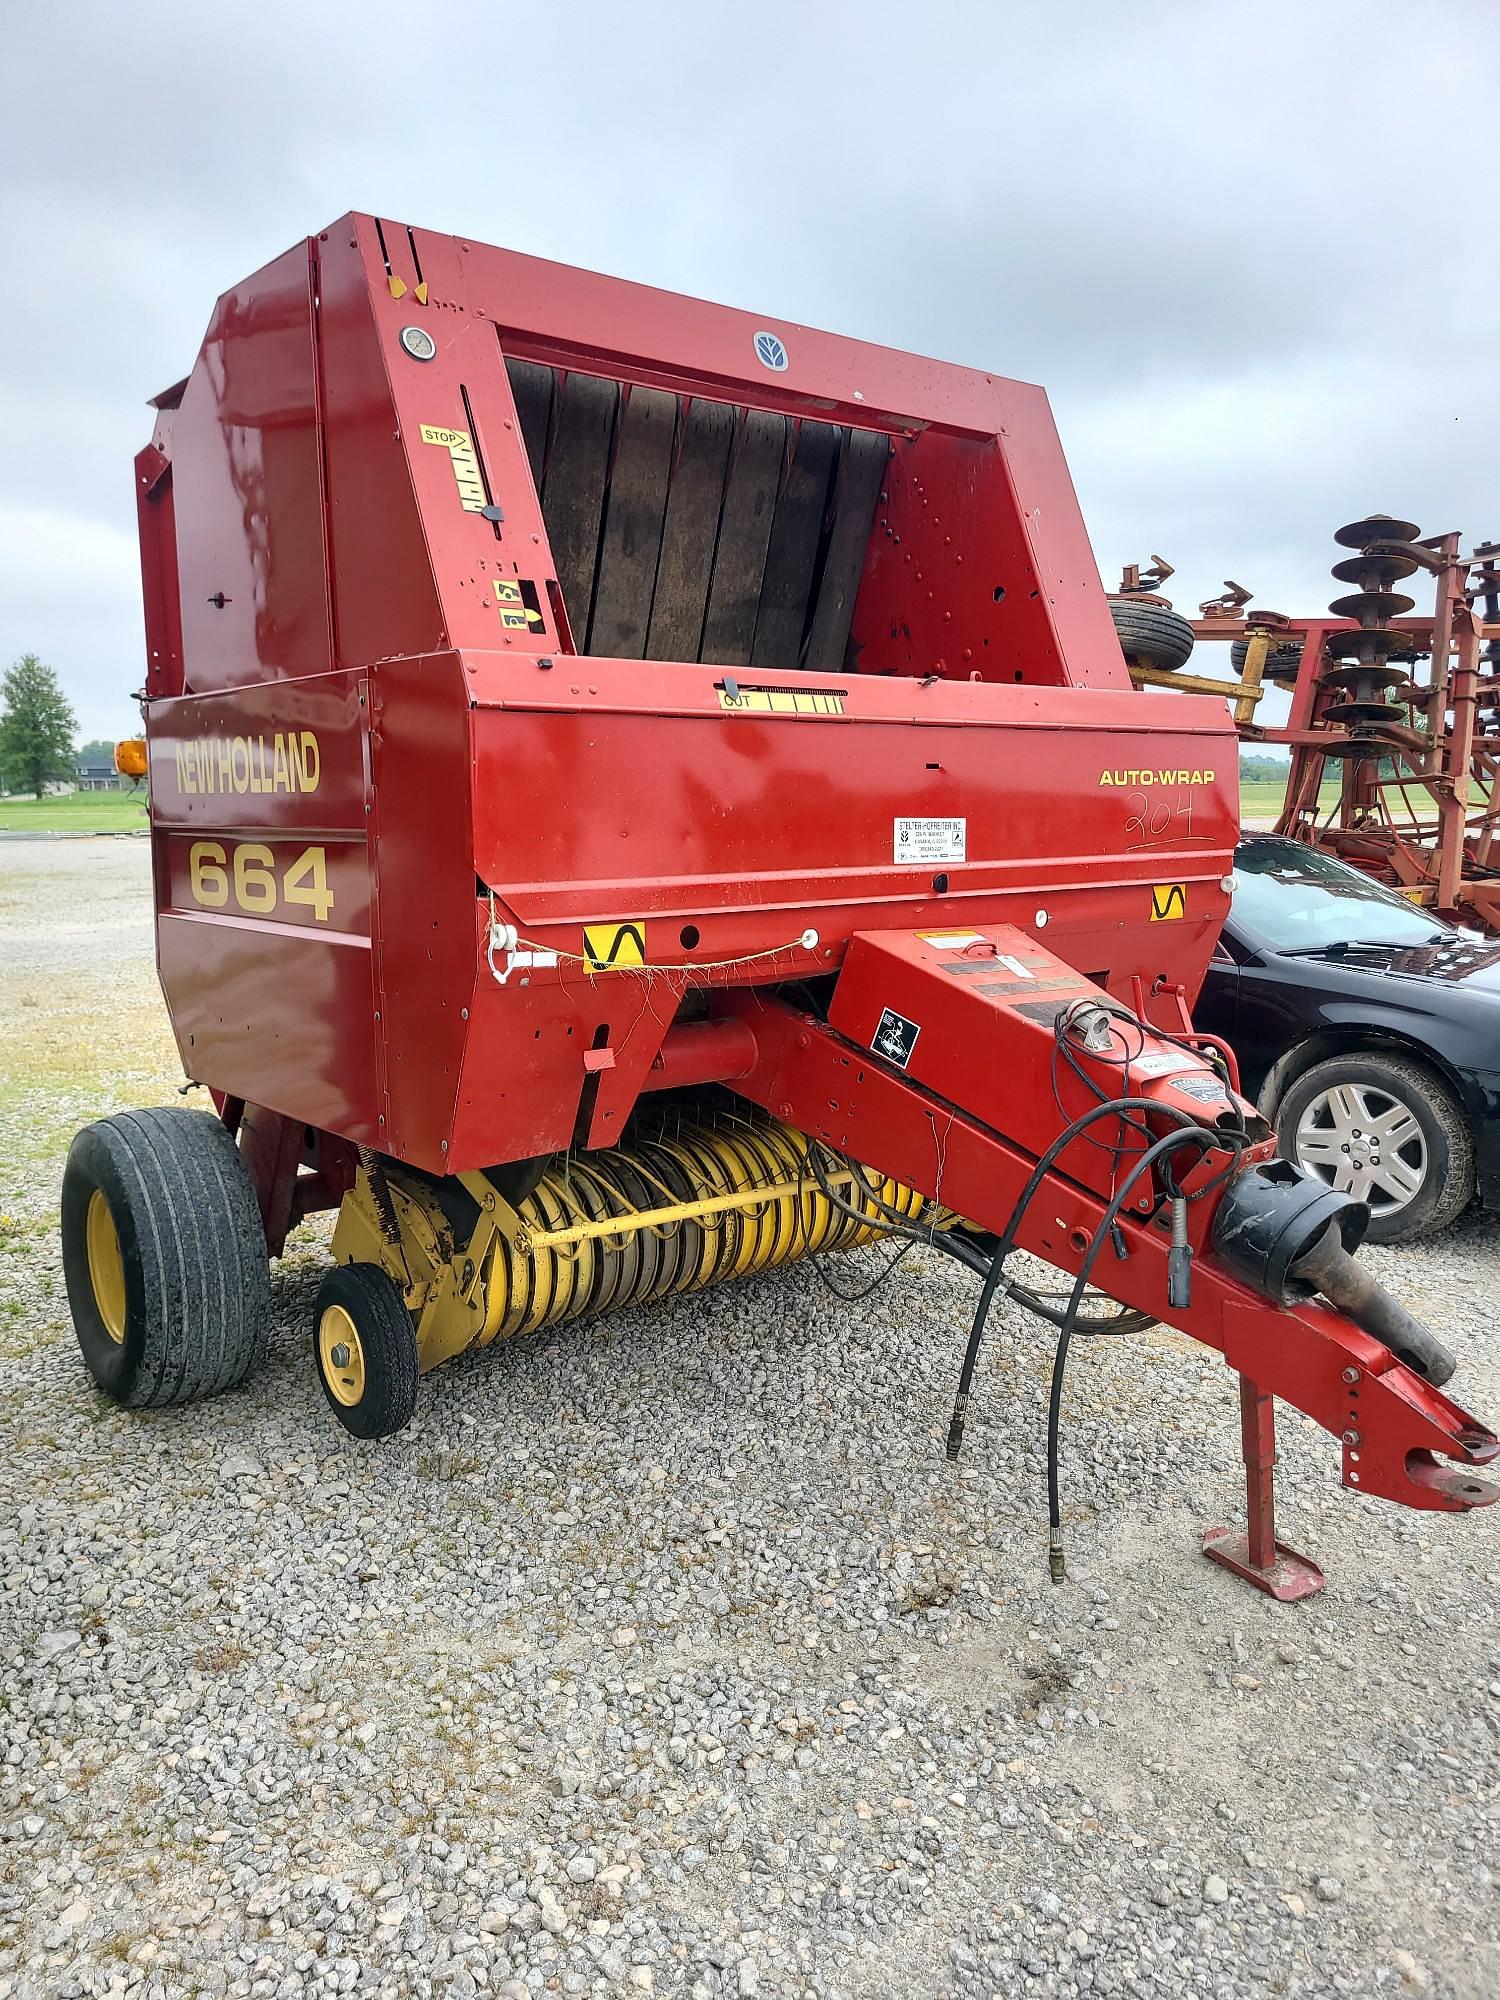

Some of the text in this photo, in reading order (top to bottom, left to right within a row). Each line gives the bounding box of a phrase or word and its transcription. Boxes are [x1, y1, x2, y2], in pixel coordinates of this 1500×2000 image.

[425, 429, 456, 443] STOP
[724, 693, 750, 707] CUT
[175, 731, 321, 794] NEW HOLLAND
[1098, 769, 1216, 786] AUTO-WRAP
[1125, 789, 1193, 838] 204
[189, 841, 335, 922] 664
